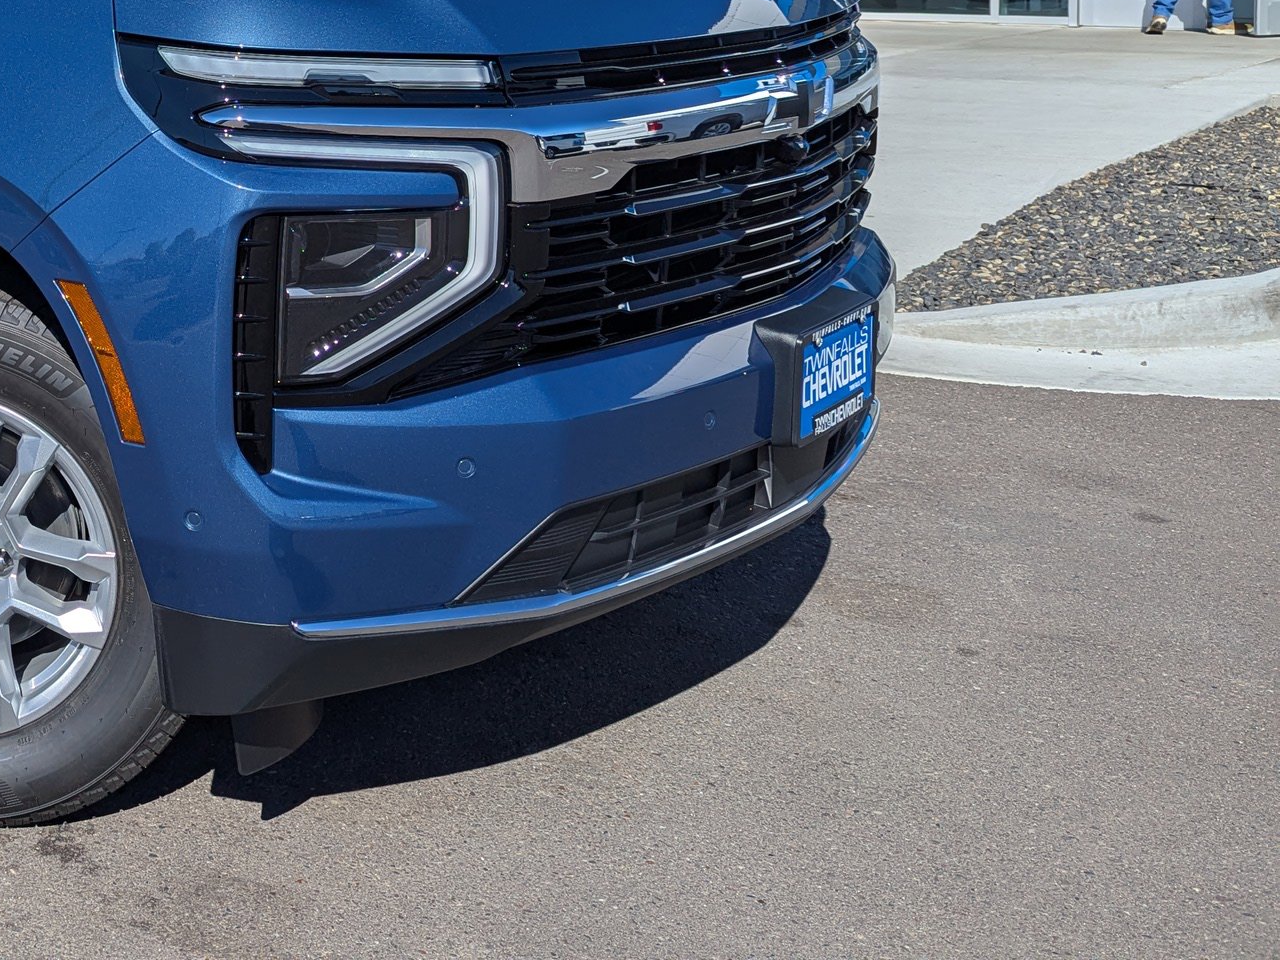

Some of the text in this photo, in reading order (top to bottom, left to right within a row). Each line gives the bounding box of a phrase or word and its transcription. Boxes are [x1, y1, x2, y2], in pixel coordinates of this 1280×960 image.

[804, 326, 868, 376] TWINFALLS
[802, 343, 868, 408] CHEVROLET
[815, 412, 831, 427] TWIN
[829, 392, 864, 427] CHEVROLET
